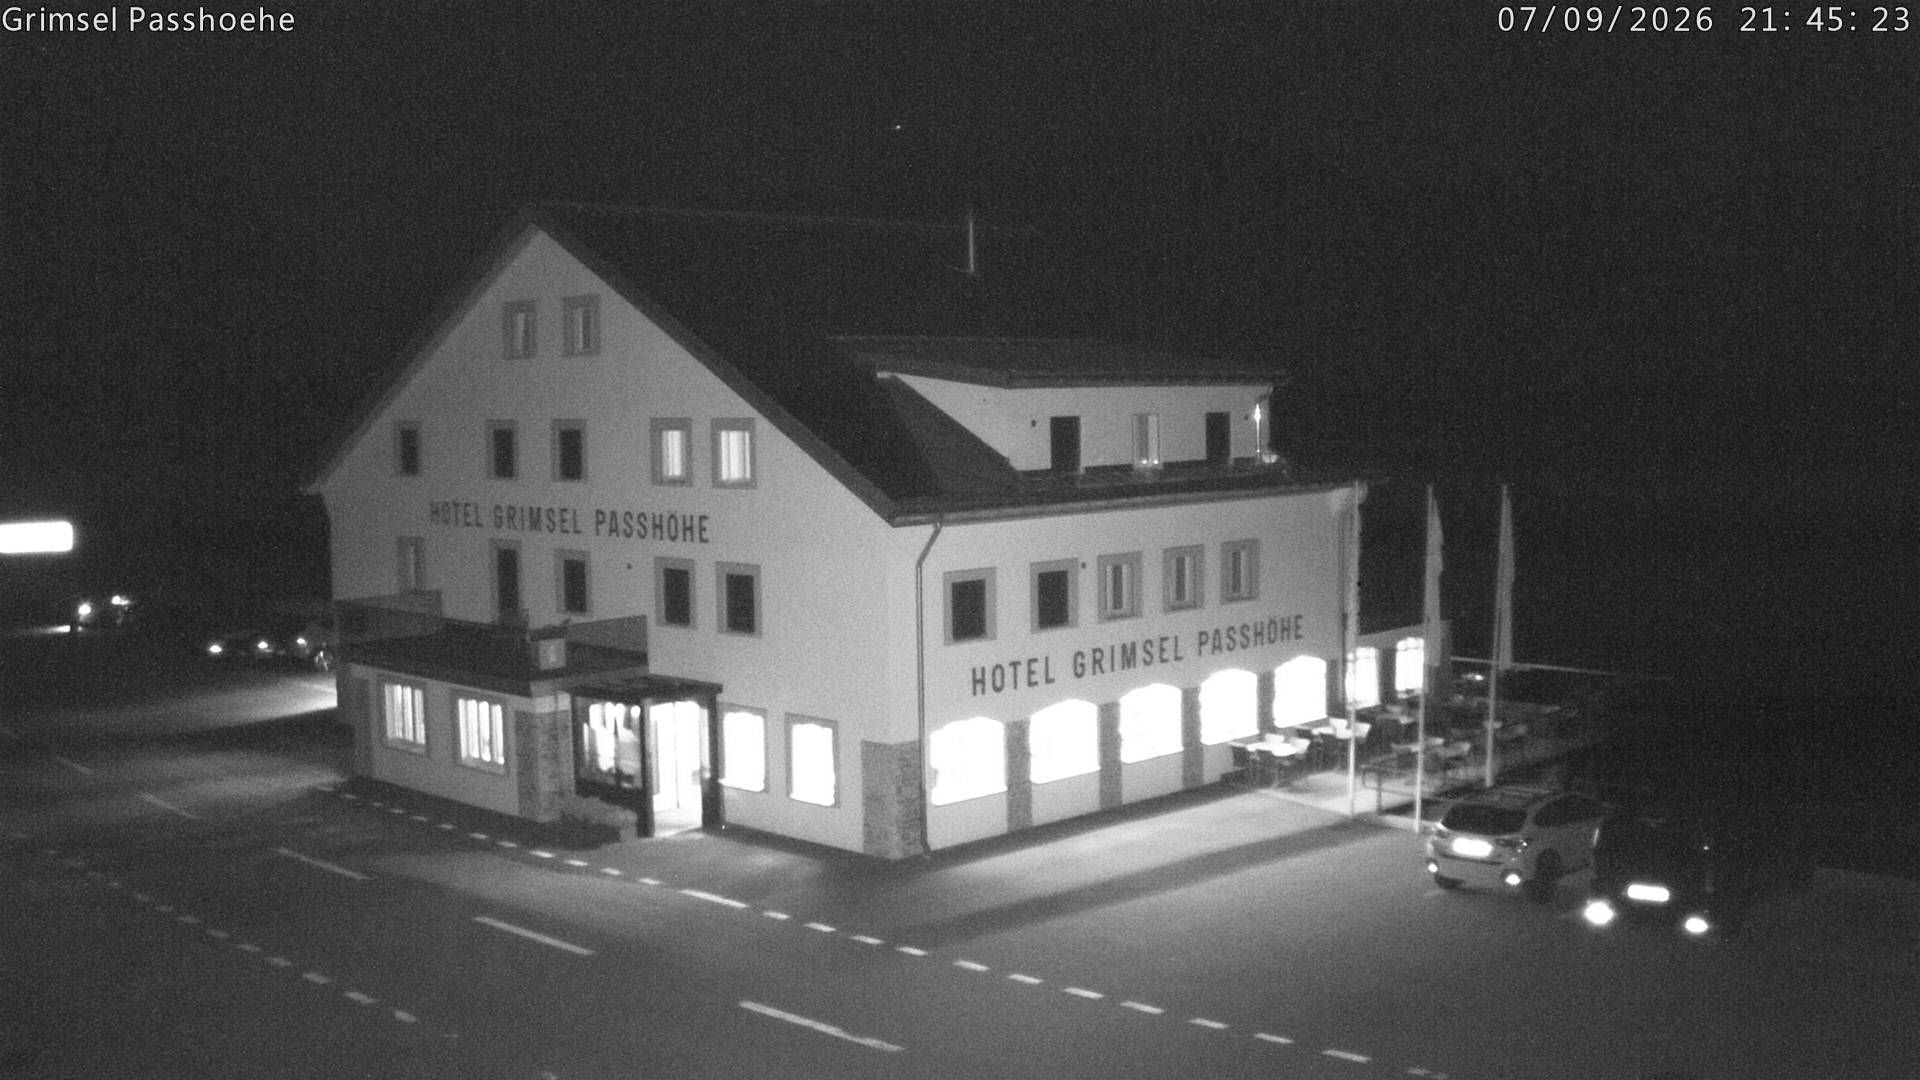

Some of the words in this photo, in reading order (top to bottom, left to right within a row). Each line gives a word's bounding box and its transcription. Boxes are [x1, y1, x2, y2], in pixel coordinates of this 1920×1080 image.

[429, 501, 484, 529] HOTEL
[493, 504, 583, 535] GRIMSEL
[594, 509, 711, 544] PASSHÖHE
[972, 656, 1056, 697] HOTEL
[1073, 635, 1185, 679] GRIMSEL
[1197, 614, 1306, 657] PASSHÖHE
